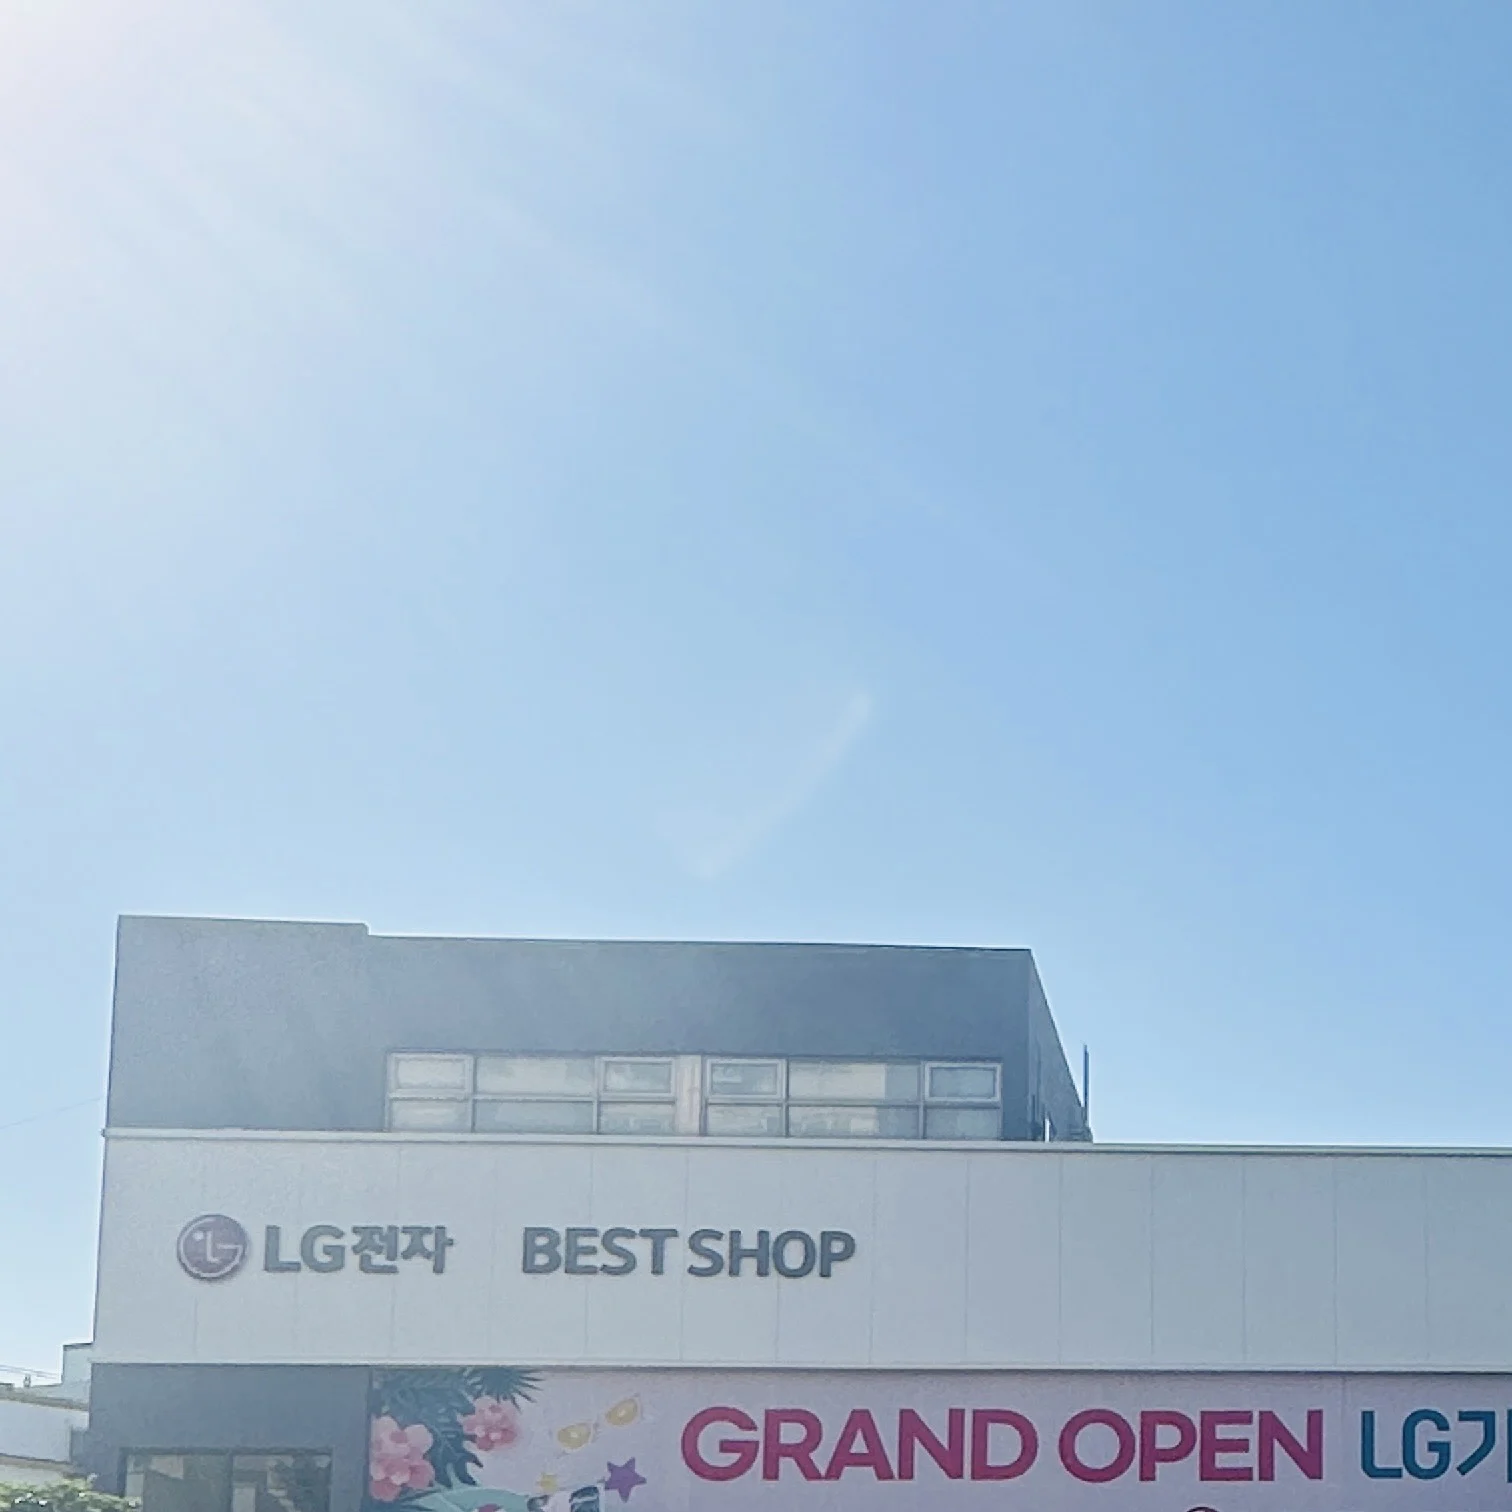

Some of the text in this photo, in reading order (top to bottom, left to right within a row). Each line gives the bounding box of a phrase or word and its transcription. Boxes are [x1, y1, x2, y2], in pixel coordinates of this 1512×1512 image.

[264, 1224, 455, 1274] LG전자
[522, 1227, 678, 1276] BEST
[687, 1228, 857, 1278] SHOP
[681, 1406, 1039, 1483] GRAND
[1058, 1408, 1324, 1484] OPEN
